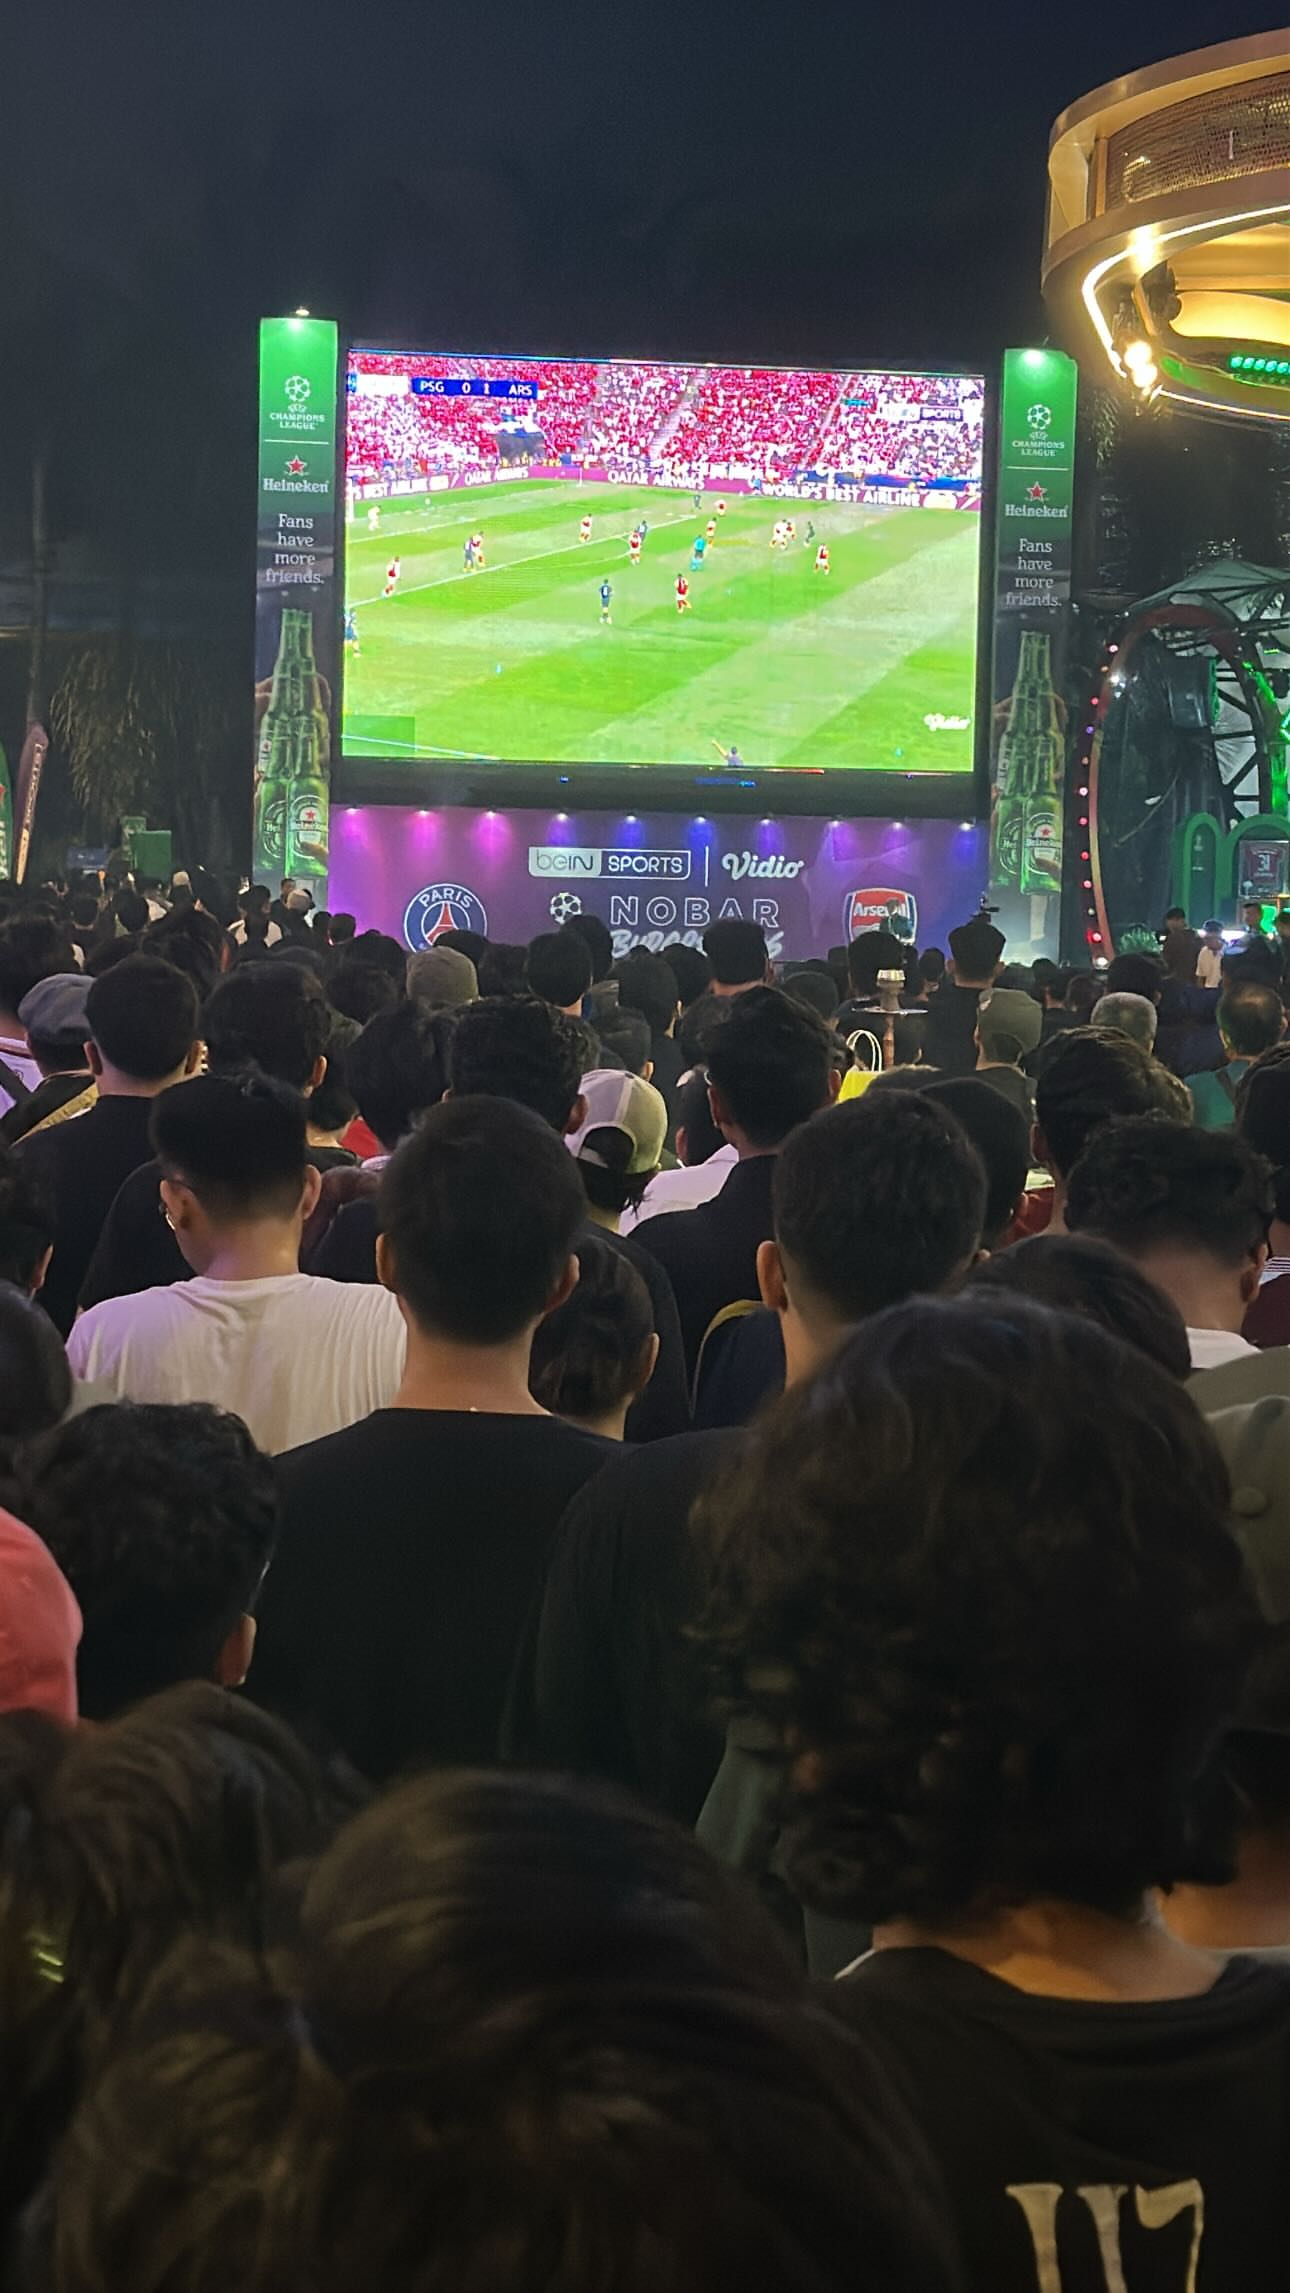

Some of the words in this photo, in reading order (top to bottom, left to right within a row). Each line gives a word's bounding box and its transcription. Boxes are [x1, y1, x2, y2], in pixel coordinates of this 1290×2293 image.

[420, 381, 445, 393] PSG
[462, 382, 472, 394] 0
[484, 383, 491, 395] 1
[508, 384, 533, 396] ARS
[269, 412, 326, 423] CHAMPIONS
[280, 421, 316, 430] LEAGUE
[1012, 440, 1065, 449] CHAMPIONS
[1021, 448, 1057, 457] LEAGUE
[263, 478, 330, 494] Heineken
[762, 483, 823, 501] WORLD'S
[825, 486, 860, 503] BEST
[862, 488, 921, 508] AIRLINE
[1004, 503, 1069, 519] Heineken
[278, 513, 314, 529] Fans
[277, 532, 314, 547] have
[1019, 537, 1053, 553] Fans
[274, 553, 316, 566] more
[1017, 555, 1053, 570] have
[265, 567, 325, 585] friends.
[1015, 577, 1054, 589] more
[1005, 591, 1063, 607] friends.
[608, 855, 683, 873] SPORTS
[722, 851, 804, 880] Vidio
[418, 887, 473, 908] PARIS
[609, 895, 780, 928] NOBAR
[853, 902, 907, 918] Arsel
